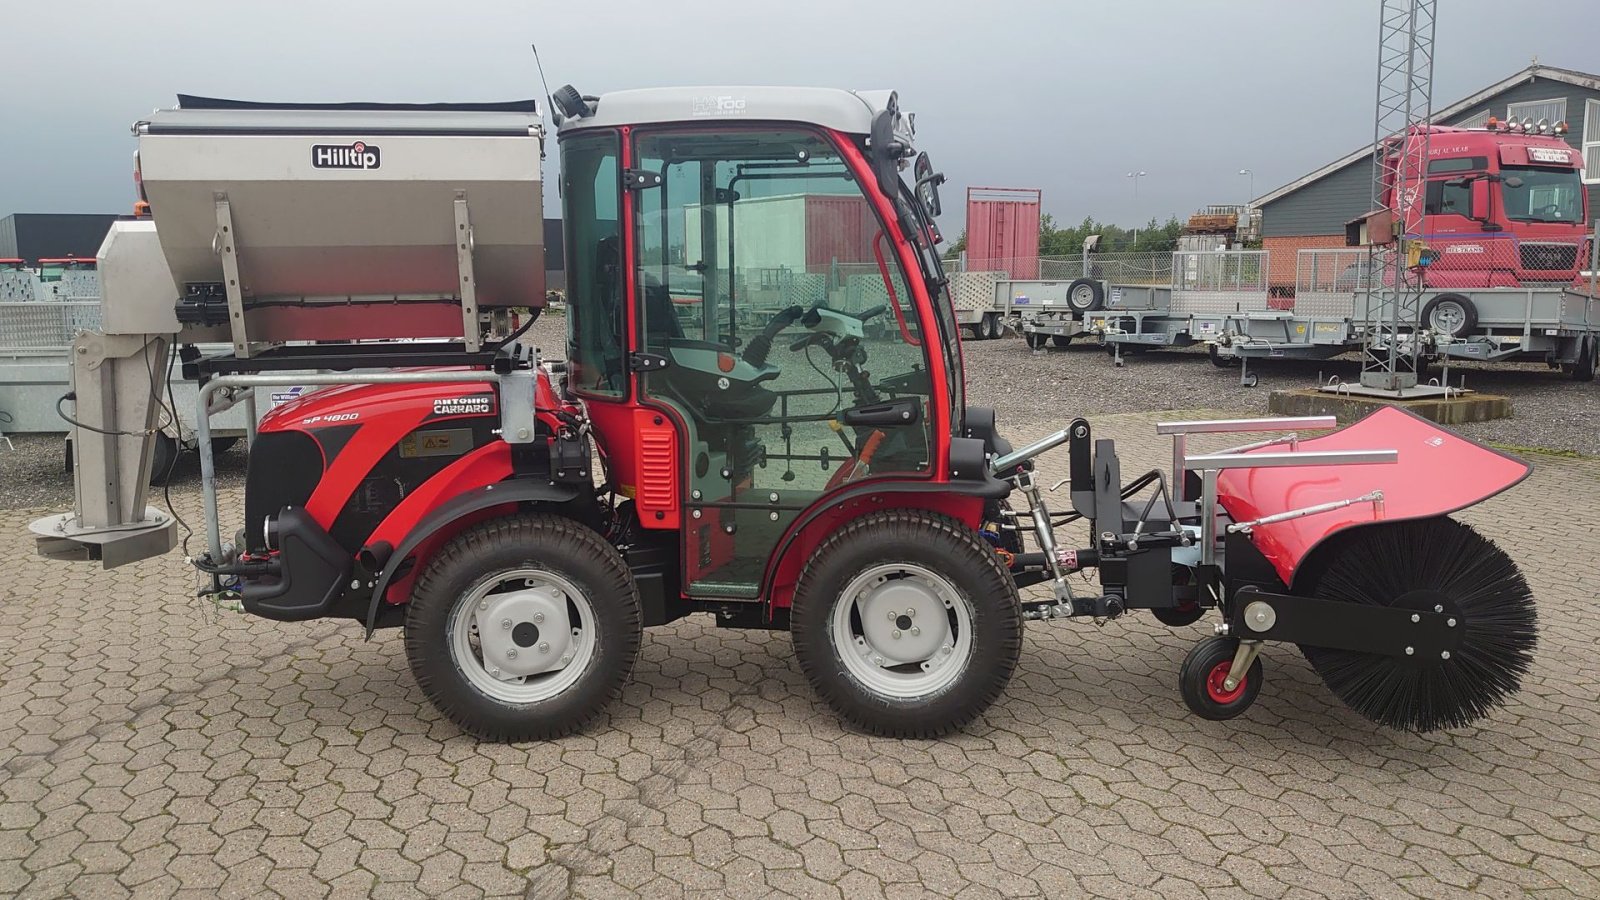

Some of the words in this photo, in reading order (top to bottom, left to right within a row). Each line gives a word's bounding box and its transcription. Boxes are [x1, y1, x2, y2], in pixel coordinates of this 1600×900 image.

[317, 148, 376, 170] Hilltip
[433, 404, 489, 414] CARRARO
[323, 413, 359, 421] 4800
